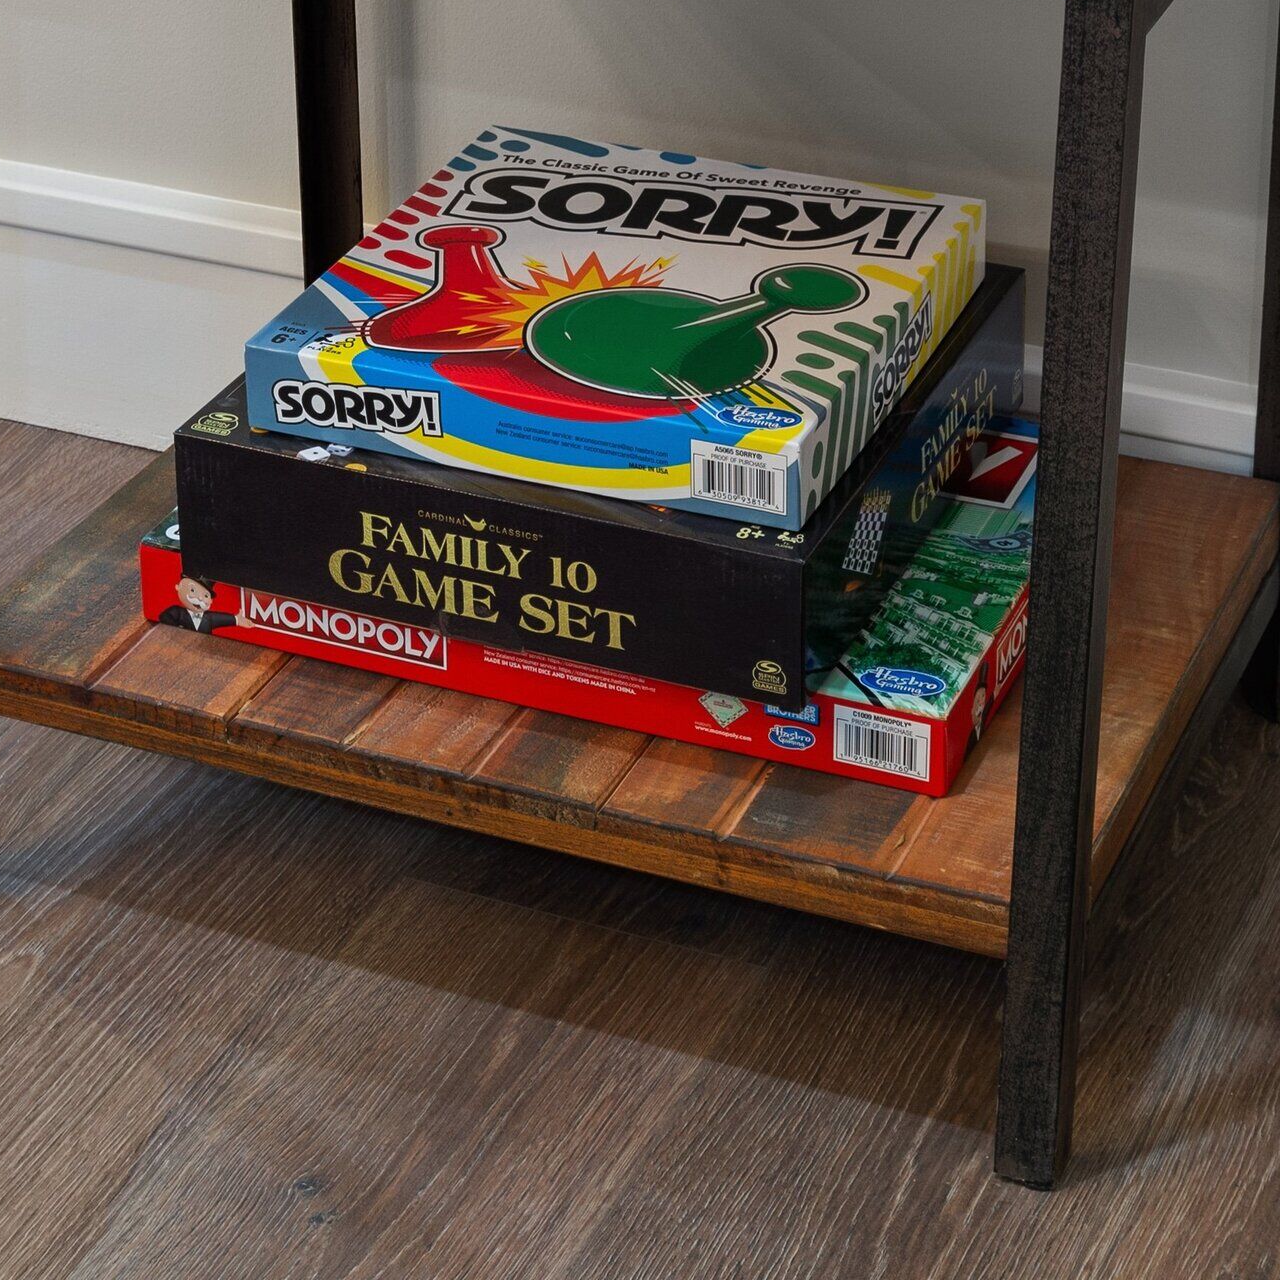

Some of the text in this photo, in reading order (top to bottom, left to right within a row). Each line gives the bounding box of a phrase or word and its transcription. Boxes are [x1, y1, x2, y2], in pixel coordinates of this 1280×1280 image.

[502, 154, 862, 195] The Classic Game Of Sweet Revenge
[464, 173, 919, 251] SORRY!
[271, 333, 297, 343] 6+
[279, 326, 308, 335] AGES
[874, 300, 932, 422] SORRY!
[277, 384, 436, 432] SORRY!
[732, 405, 795, 424] Hasbro
[733, 415, 780, 429] Gaming
[921, 387, 970, 474] FAMILY
[974, 368, 988, 401] 10
[710, 453, 727, 462] PROOF
[739, 459, 767, 468] PURCHASE
[910, 435, 962, 524] GAME
[965, 384, 998, 451] SET
[629, 462, 669, 475] MADE IN USA
[712, 491, 738, 501] 30509
[418, 509, 467, 527] CARDINAL
[359, 510, 598, 594] FAMILY 10
[328, 548, 637, 651] GAME SET
[250, 592, 441, 659] MONOPOLY
[484, 656, 500, 664] MADE
[509, 661, 521, 670] USA
[522, 665, 537, 673] WITH
[538, 668, 551, 676] DICE
[552, 671, 565, 679] AND
[566, 674, 590, 685] TOKENS
[590, 680, 607, 689] MADE
[616, 685, 637, 695] CHINA.
[875, 667, 938, 689] Hasbro
[754, 682, 784, 693] GAMES
[876, 678, 924, 696] Gaming
[773, 725, 811, 743] Hasbro
[852, 718, 871, 727] PROOF
[882, 725, 913, 736] PURCHASE
